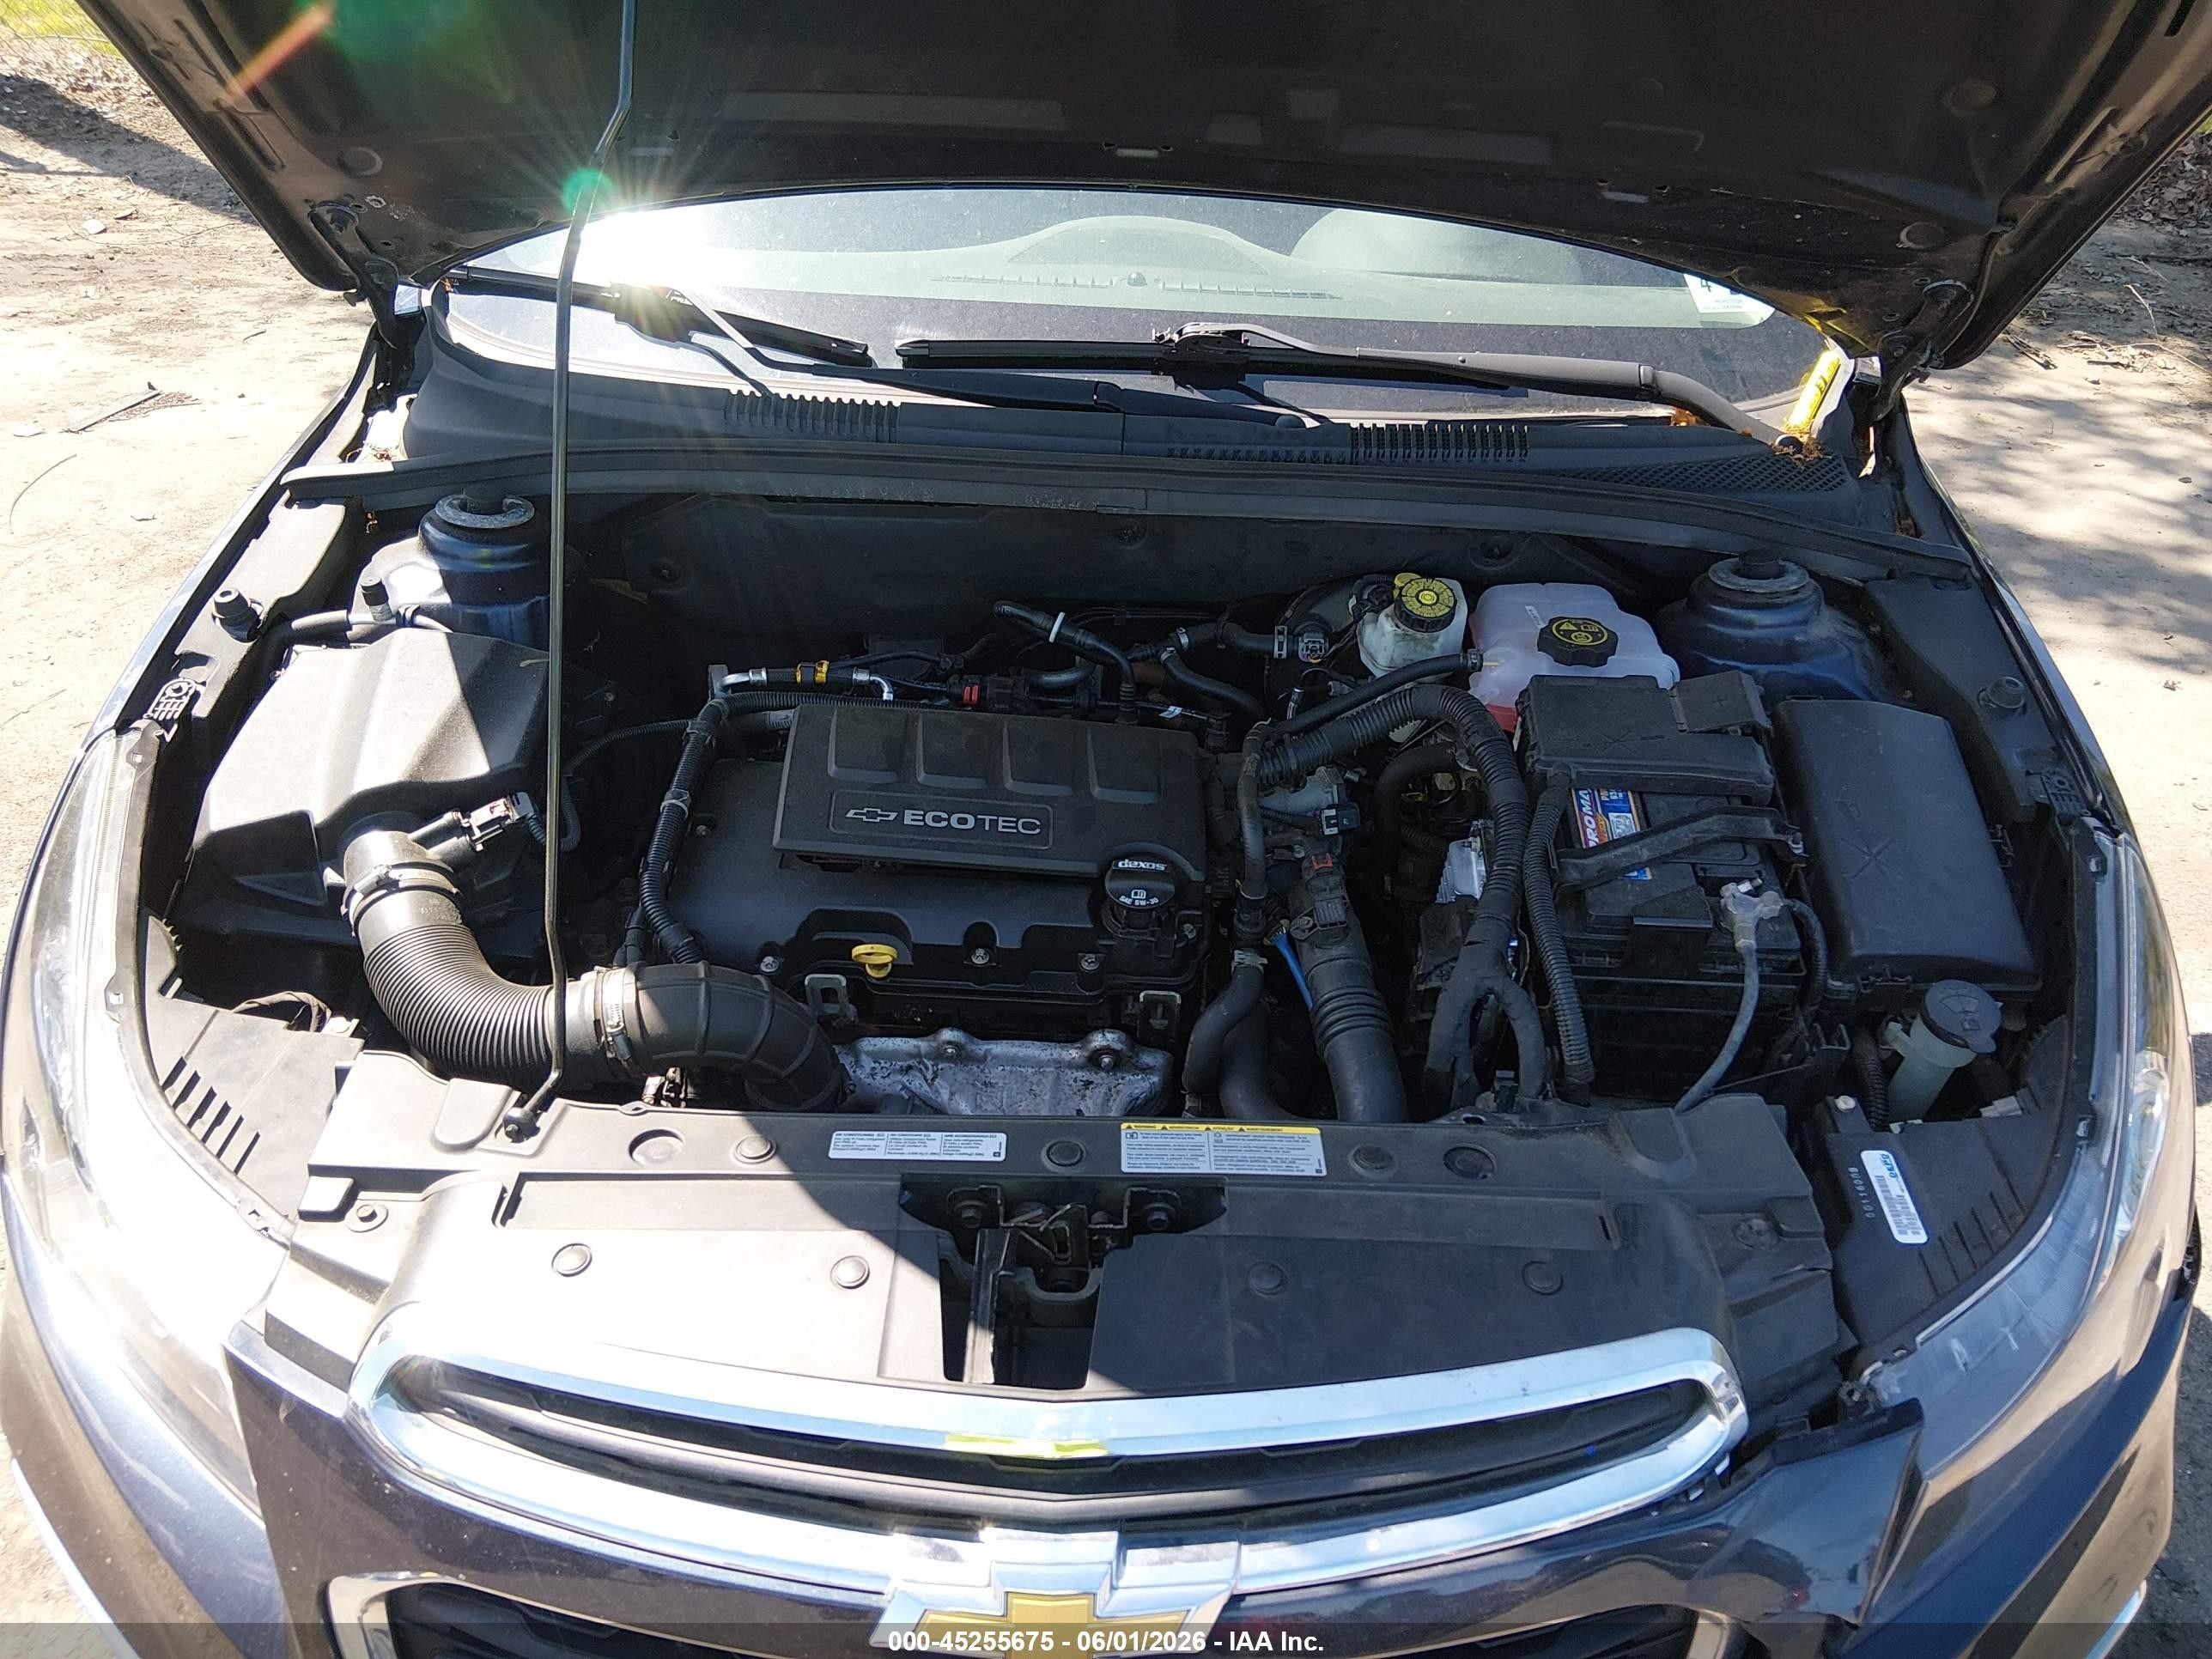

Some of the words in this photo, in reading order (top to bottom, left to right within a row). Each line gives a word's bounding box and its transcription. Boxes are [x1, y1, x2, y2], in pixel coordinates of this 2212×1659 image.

[903, 809, 1042, 836] ECOTEC
[1117, 859, 1168, 871] dexos
[1119, 895, 1133, 905] SAE
